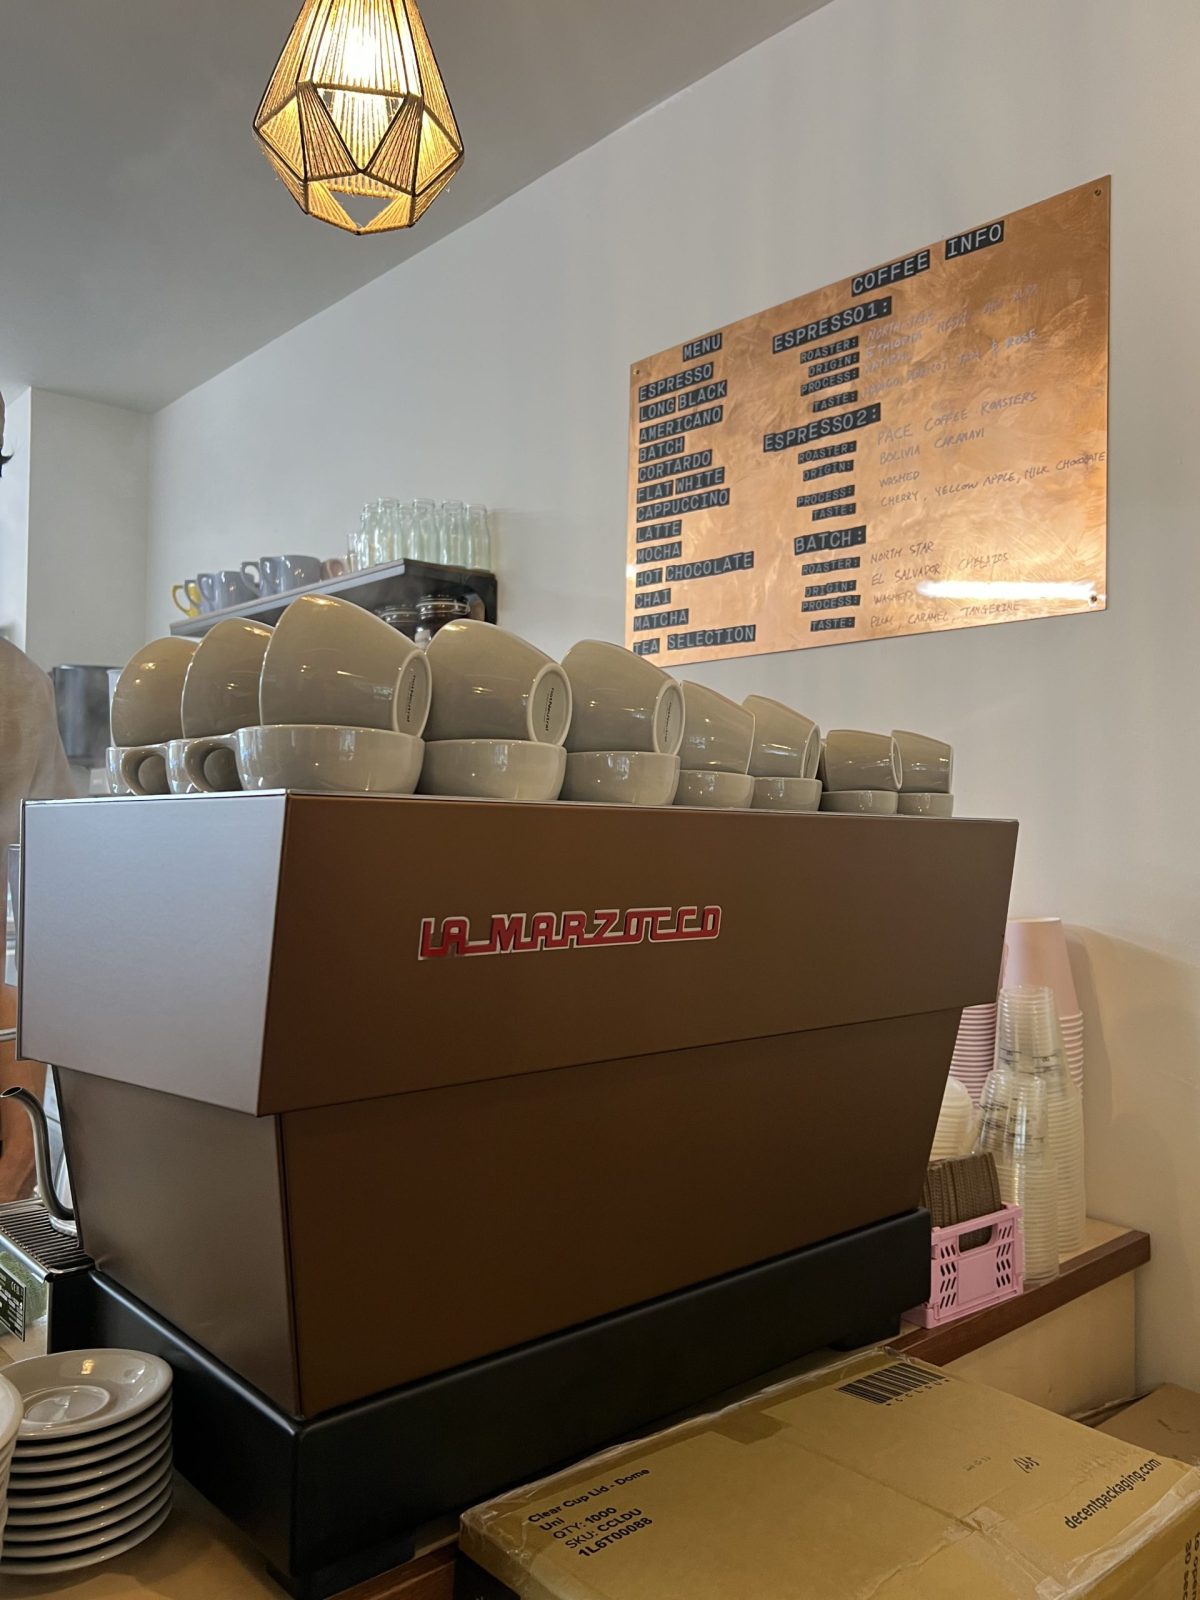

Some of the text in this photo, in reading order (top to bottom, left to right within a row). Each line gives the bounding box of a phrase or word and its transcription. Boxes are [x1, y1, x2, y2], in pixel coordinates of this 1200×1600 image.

[853, 222, 1003, 296] COFFEE INFO
[773, 299, 891, 353] ESPRESSO1:
[684, 334, 722, 361] MENU
[801, 338, 858, 363] ROASTER:
[809, 354, 859, 376] ORIGIN:
[639, 364, 714, 402] ESPRESSO
[801, 369, 859, 396] PROCESS:
[640, 381, 727, 423] LONG BLACK
[813, 392, 858, 412] TASTE:
[640, 406, 723, 444] AMERICANO
[764, 404, 880, 452] ESPRESSO2:
[878, 390, 1037, 446] PACE COFFEE ROASTERS
[639, 437, 685, 463] BATCH
[798, 442, 856, 463] ROASTER:
[880, 445, 920, 465] BOLIVIA
[639, 450, 712, 483] CORTARDO
[803, 461, 854, 481] ORIGIN:
[880, 470, 920, 488] WASHED
[637, 468, 724, 503] FLAT WHITE
[935, 478, 978, 498] YELLOW
[1024, 465, 1049, 482] MILK
[637, 489, 730, 522] CAPPUCCINO
[797, 486, 855, 507] PROCESS:
[812, 504, 856, 521] TASTE:
[637, 521, 682, 543] LATTE
[637, 543, 682, 564] MOCHA
[870, 541, 935, 565] NORTH STAR
[636, 553, 754, 588] HOT CHOCOLATE
[802, 558, 860, 576] ROASTER:
[871, 572, 884, 586] EL
[895, 563, 941, 583] SALVADOR
[635, 590, 671, 609] CHAI
[805, 581, 857, 598] ORIGIN:
[802, 596, 860, 612] PROCESS:
[634, 610, 689, 631] MATCHA
[811, 618, 855, 632] TASTE:
[634, 627, 756, 655] TEA SELECTION
[418, 905, 722, 960] LA MARZOCCO
[528, 1505, 562, 1522] Clear
[563, 1495, 590, 1508] Cup
[588, 1485, 609, 1498] Lid
[615, 1468, 650, 1485] Dome
[1064, 1458, 1162, 1529] decentpackaging.com
[539, 1517, 565, 1531] Uni
[553, 1507, 617, 1539] QTY: 1000
[565, 1508, 642, 1549] SKU: CCLDU
[578, 1517, 653, 1557] 1L6T00088
